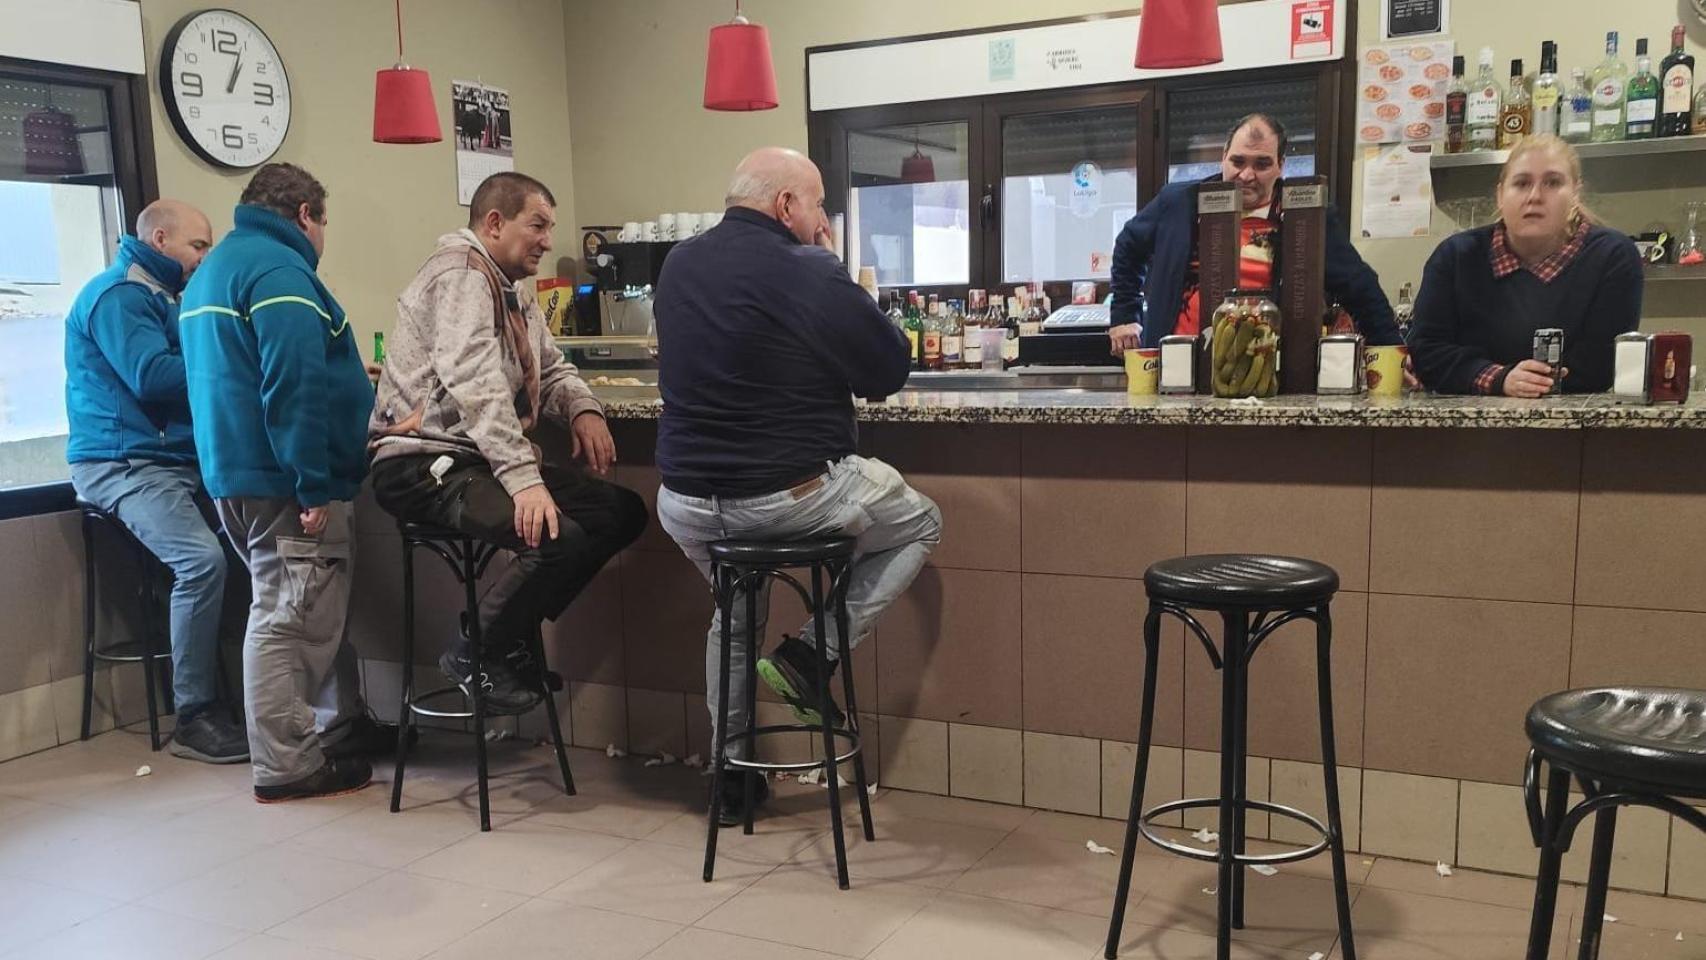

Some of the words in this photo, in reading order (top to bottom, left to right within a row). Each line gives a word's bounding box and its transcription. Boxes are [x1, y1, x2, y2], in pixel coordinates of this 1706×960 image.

[211, 28, 239, 55] 12
[184, 52, 199, 65] 10
[256, 62, 267, 75] 2
[180, 71, 204, 98] 9
[253, 82, 275, 107] 3
[189, 105, 201, 119] 8
[261, 115, 270, 128] 4
[207, 128, 218, 141] 7
[222, 124, 243, 150] 6
[247, 132, 258, 145] 5
